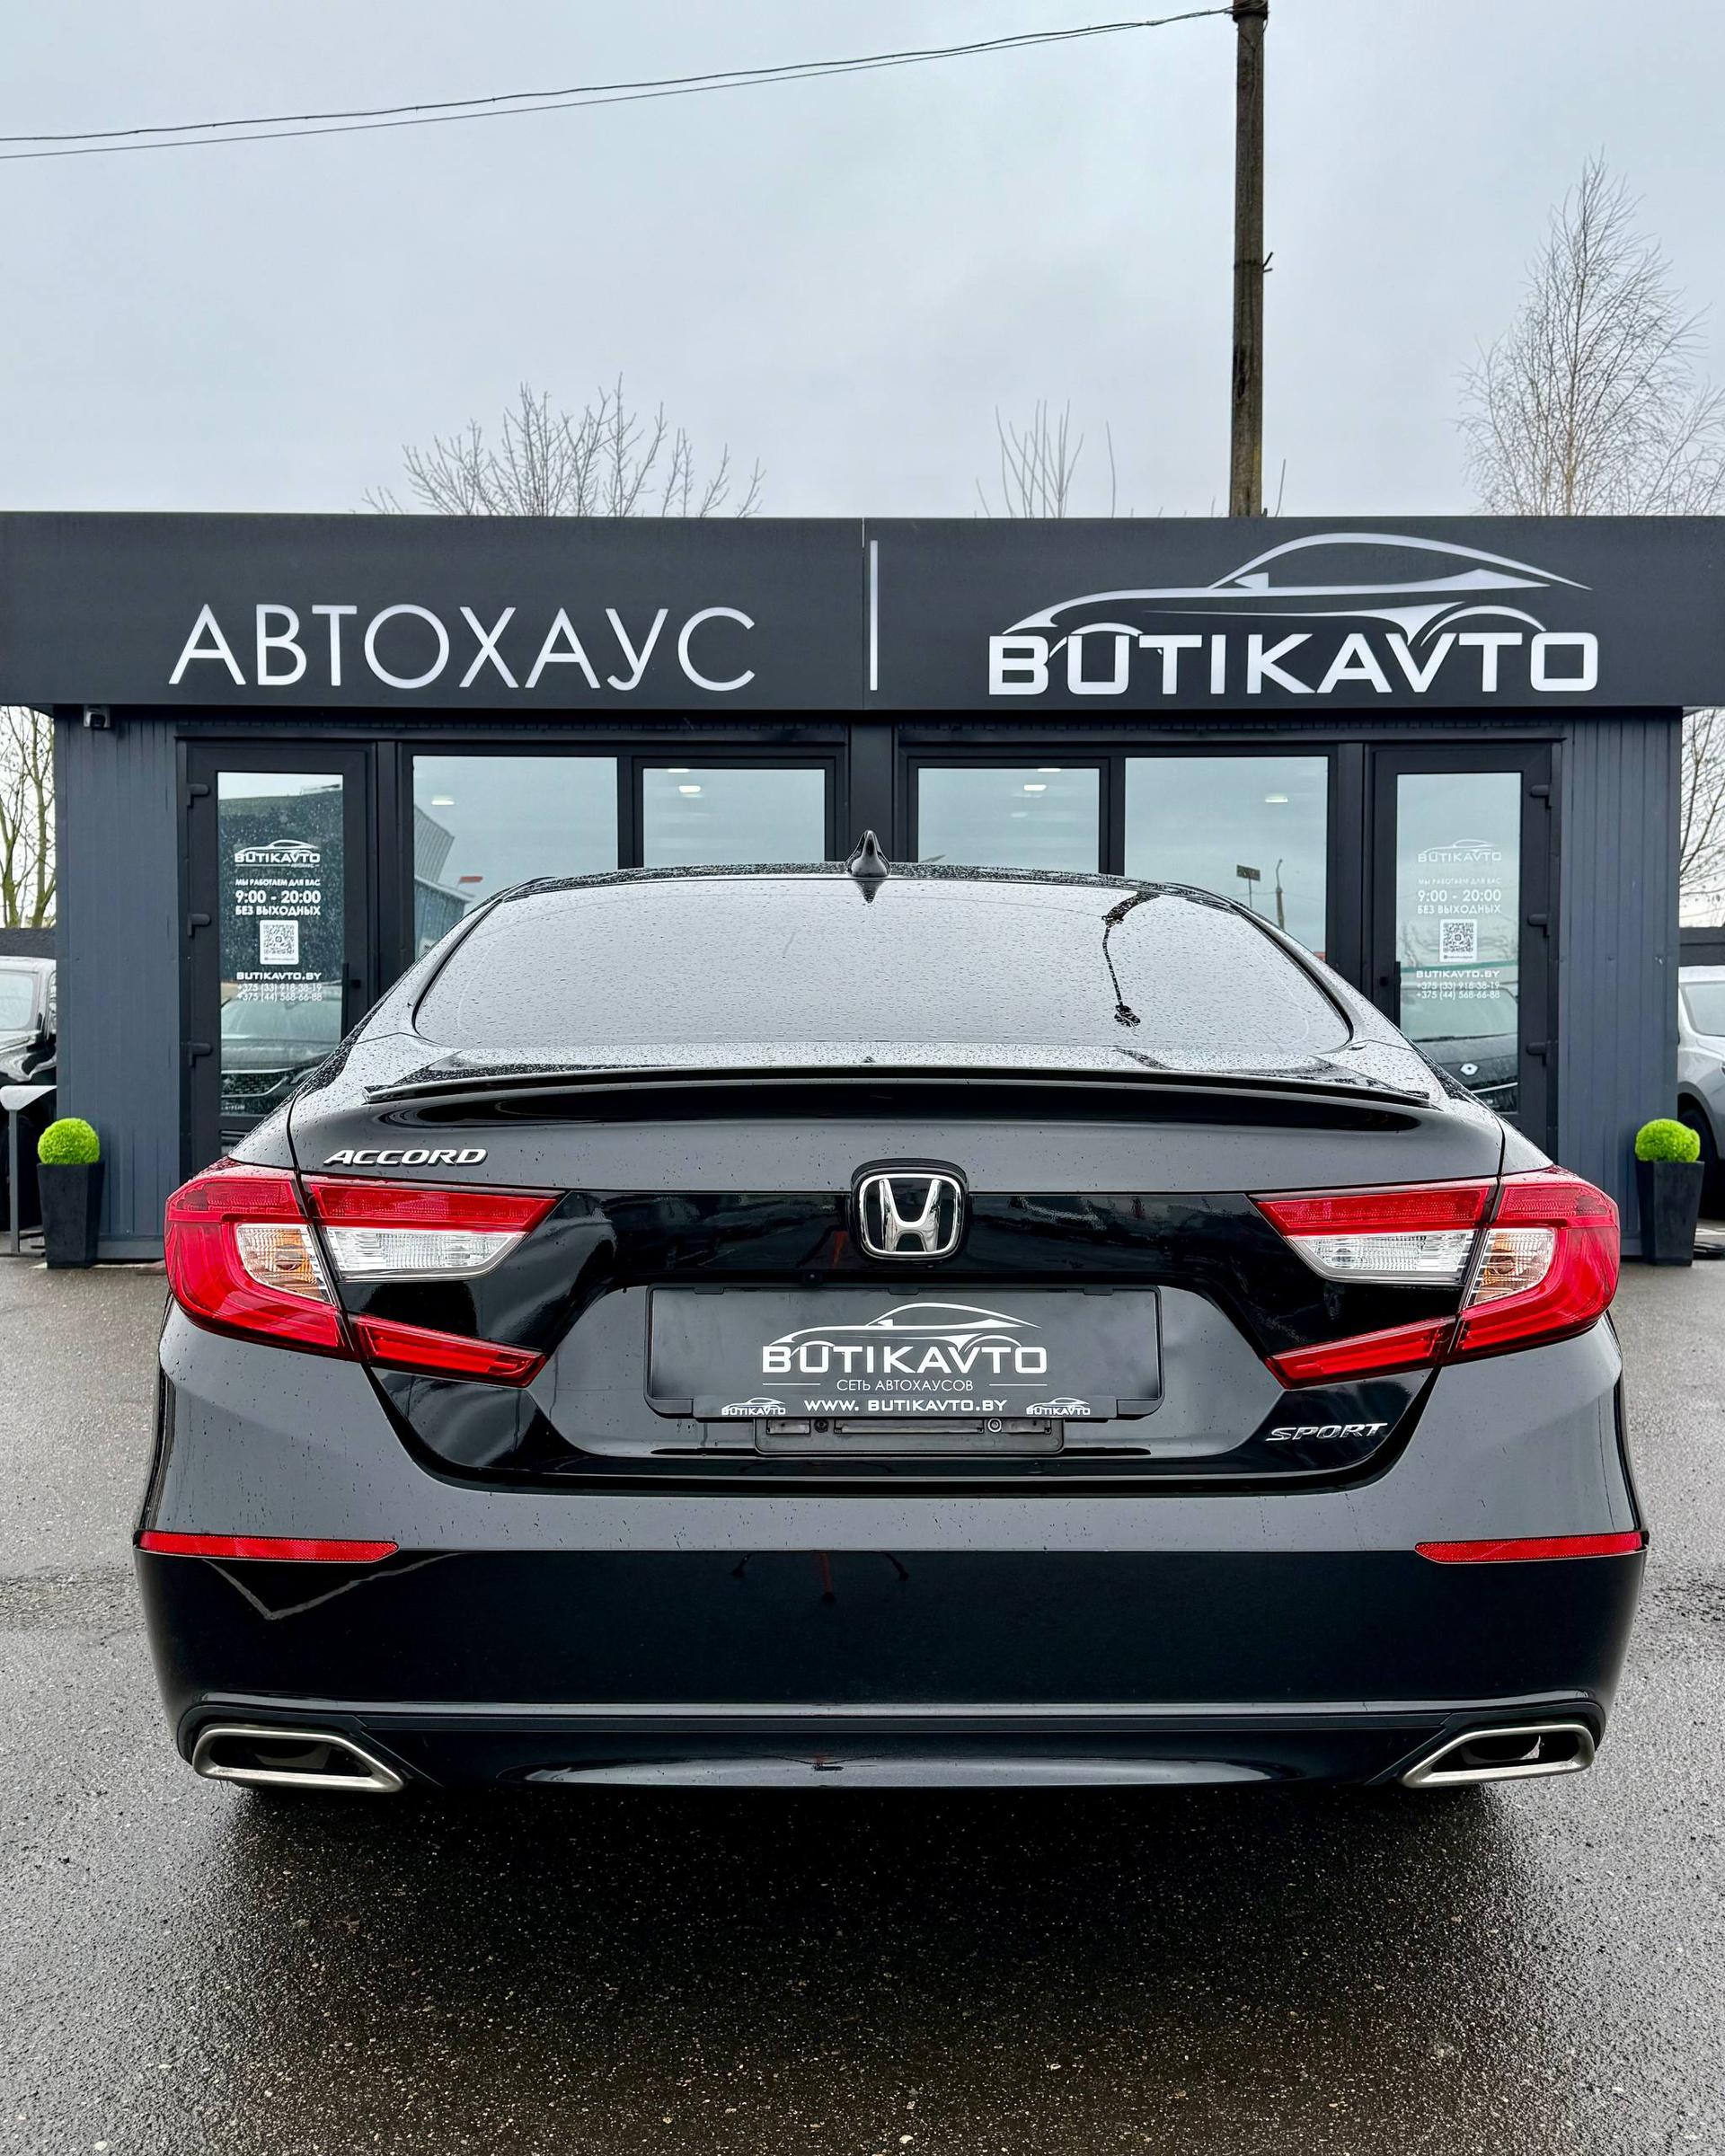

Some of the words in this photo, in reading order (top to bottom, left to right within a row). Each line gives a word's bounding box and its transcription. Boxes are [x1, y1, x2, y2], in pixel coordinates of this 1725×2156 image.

[168, 603, 756, 692] АВТОХАУС
[988, 632, 1598, 695] BUTIKAVTO
[234, 853, 320, 863] BUTIKAVTO
[1417, 852, 1502, 862] BUTIKAVTO
[288, 879, 304, 887] ДЛЯ
[235, 890, 266, 904] 9:00
[281, 890, 321, 904] 20:00
[1418, 889, 1447, 902] 9:00
[1463, 889, 1501, 902] 20:00
[235, 906, 253, 915] БЕЗ
[256, 906, 321, 916] ВЫХОДНЫХ
[1417, 905, 1435, 915] БЕЗ
[1438, 905, 1501, 915] ВЫХОДНЫХ
[236, 972, 322, 980] BUTIKAVTO.BY
[1416, 970, 1500, 978] BUTIKAVTO.BY
[237, 983, 259, 992] +375
[261, 983, 278, 993] (33)
[1417, 982, 1438, 990] +375
[237, 993, 259, 1001] +375
[261, 993, 278, 1002] (44)
[1417, 991, 1438, 999] +375
[1439, 991, 1455, 1000] (44)
[323, 1149, 488, 1166] ACCORD
[762, 1346, 1048, 1374] BUTIKAVTO
[836, 1379, 871, 1392] СЕТЬ
[875, 1379, 974, 1392] АВТОХАУСОВ
[868, 1399, 1007, 1412] BUTIKAVTO.BY
[721, 1407, 786, 1416] BUTIKAVTO
[1026, 1407, 1091, 1416] BUTIKAVTO
[1265, 1422, 1388, 1442] SPORT
